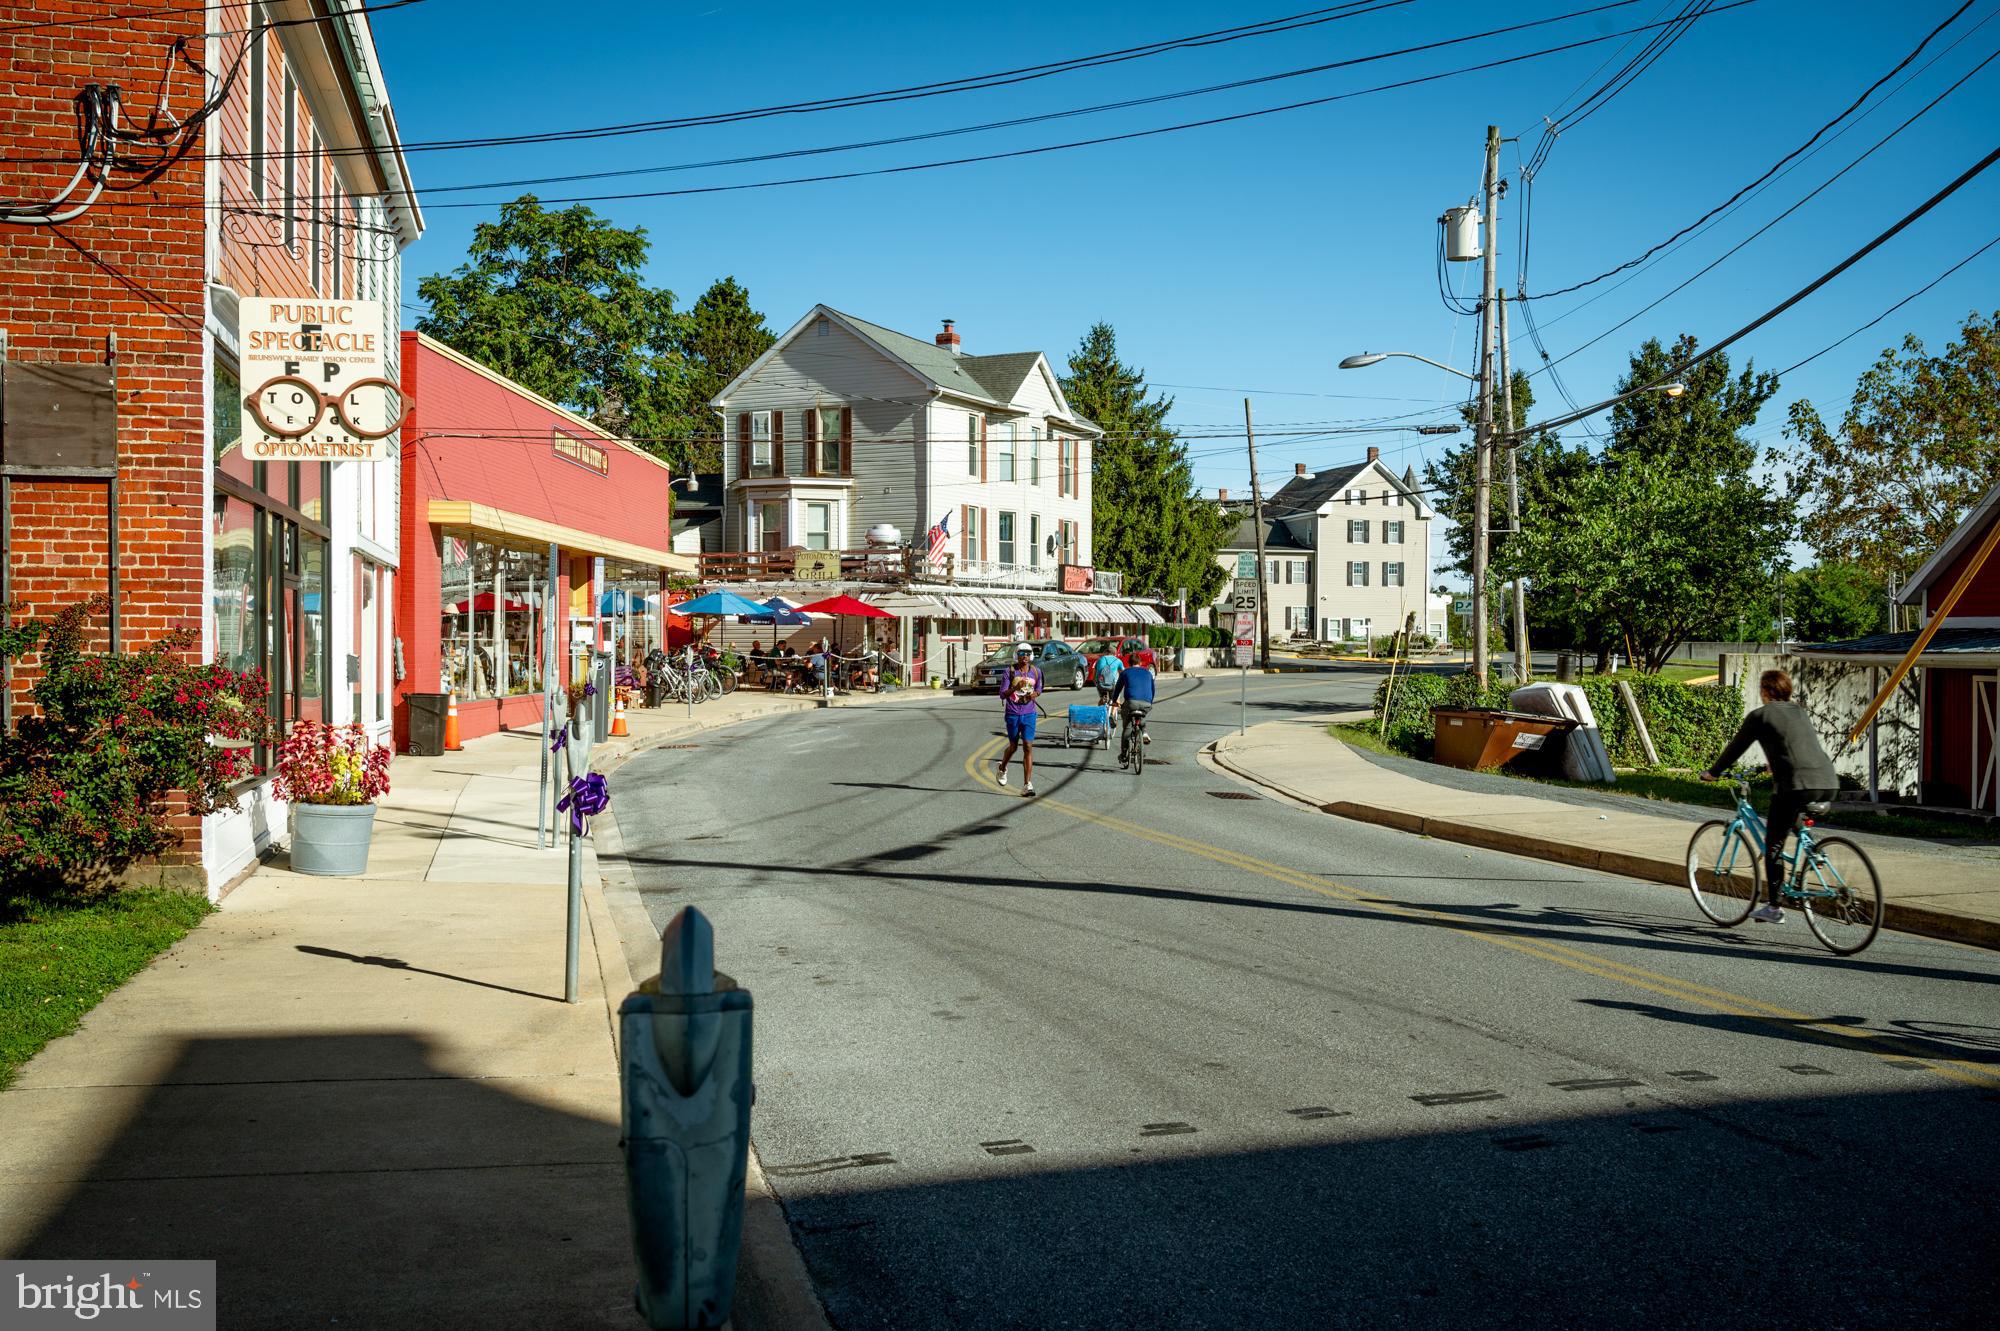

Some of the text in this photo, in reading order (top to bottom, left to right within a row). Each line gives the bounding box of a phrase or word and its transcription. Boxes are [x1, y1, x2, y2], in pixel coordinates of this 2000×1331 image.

[270, 304, 352, 325] PUBLIC
[248, 331, 375, 352] SPECTACLE
[323, 362, 340, 382] P
[267, 392, 359, 405] T O L
[287, 416, 293, 424] E
[254, 442, 375, 457] OPTOMETRIST
[798, 568, 837, 580] GRILL
[1235, 596, 1256, 608] 25
